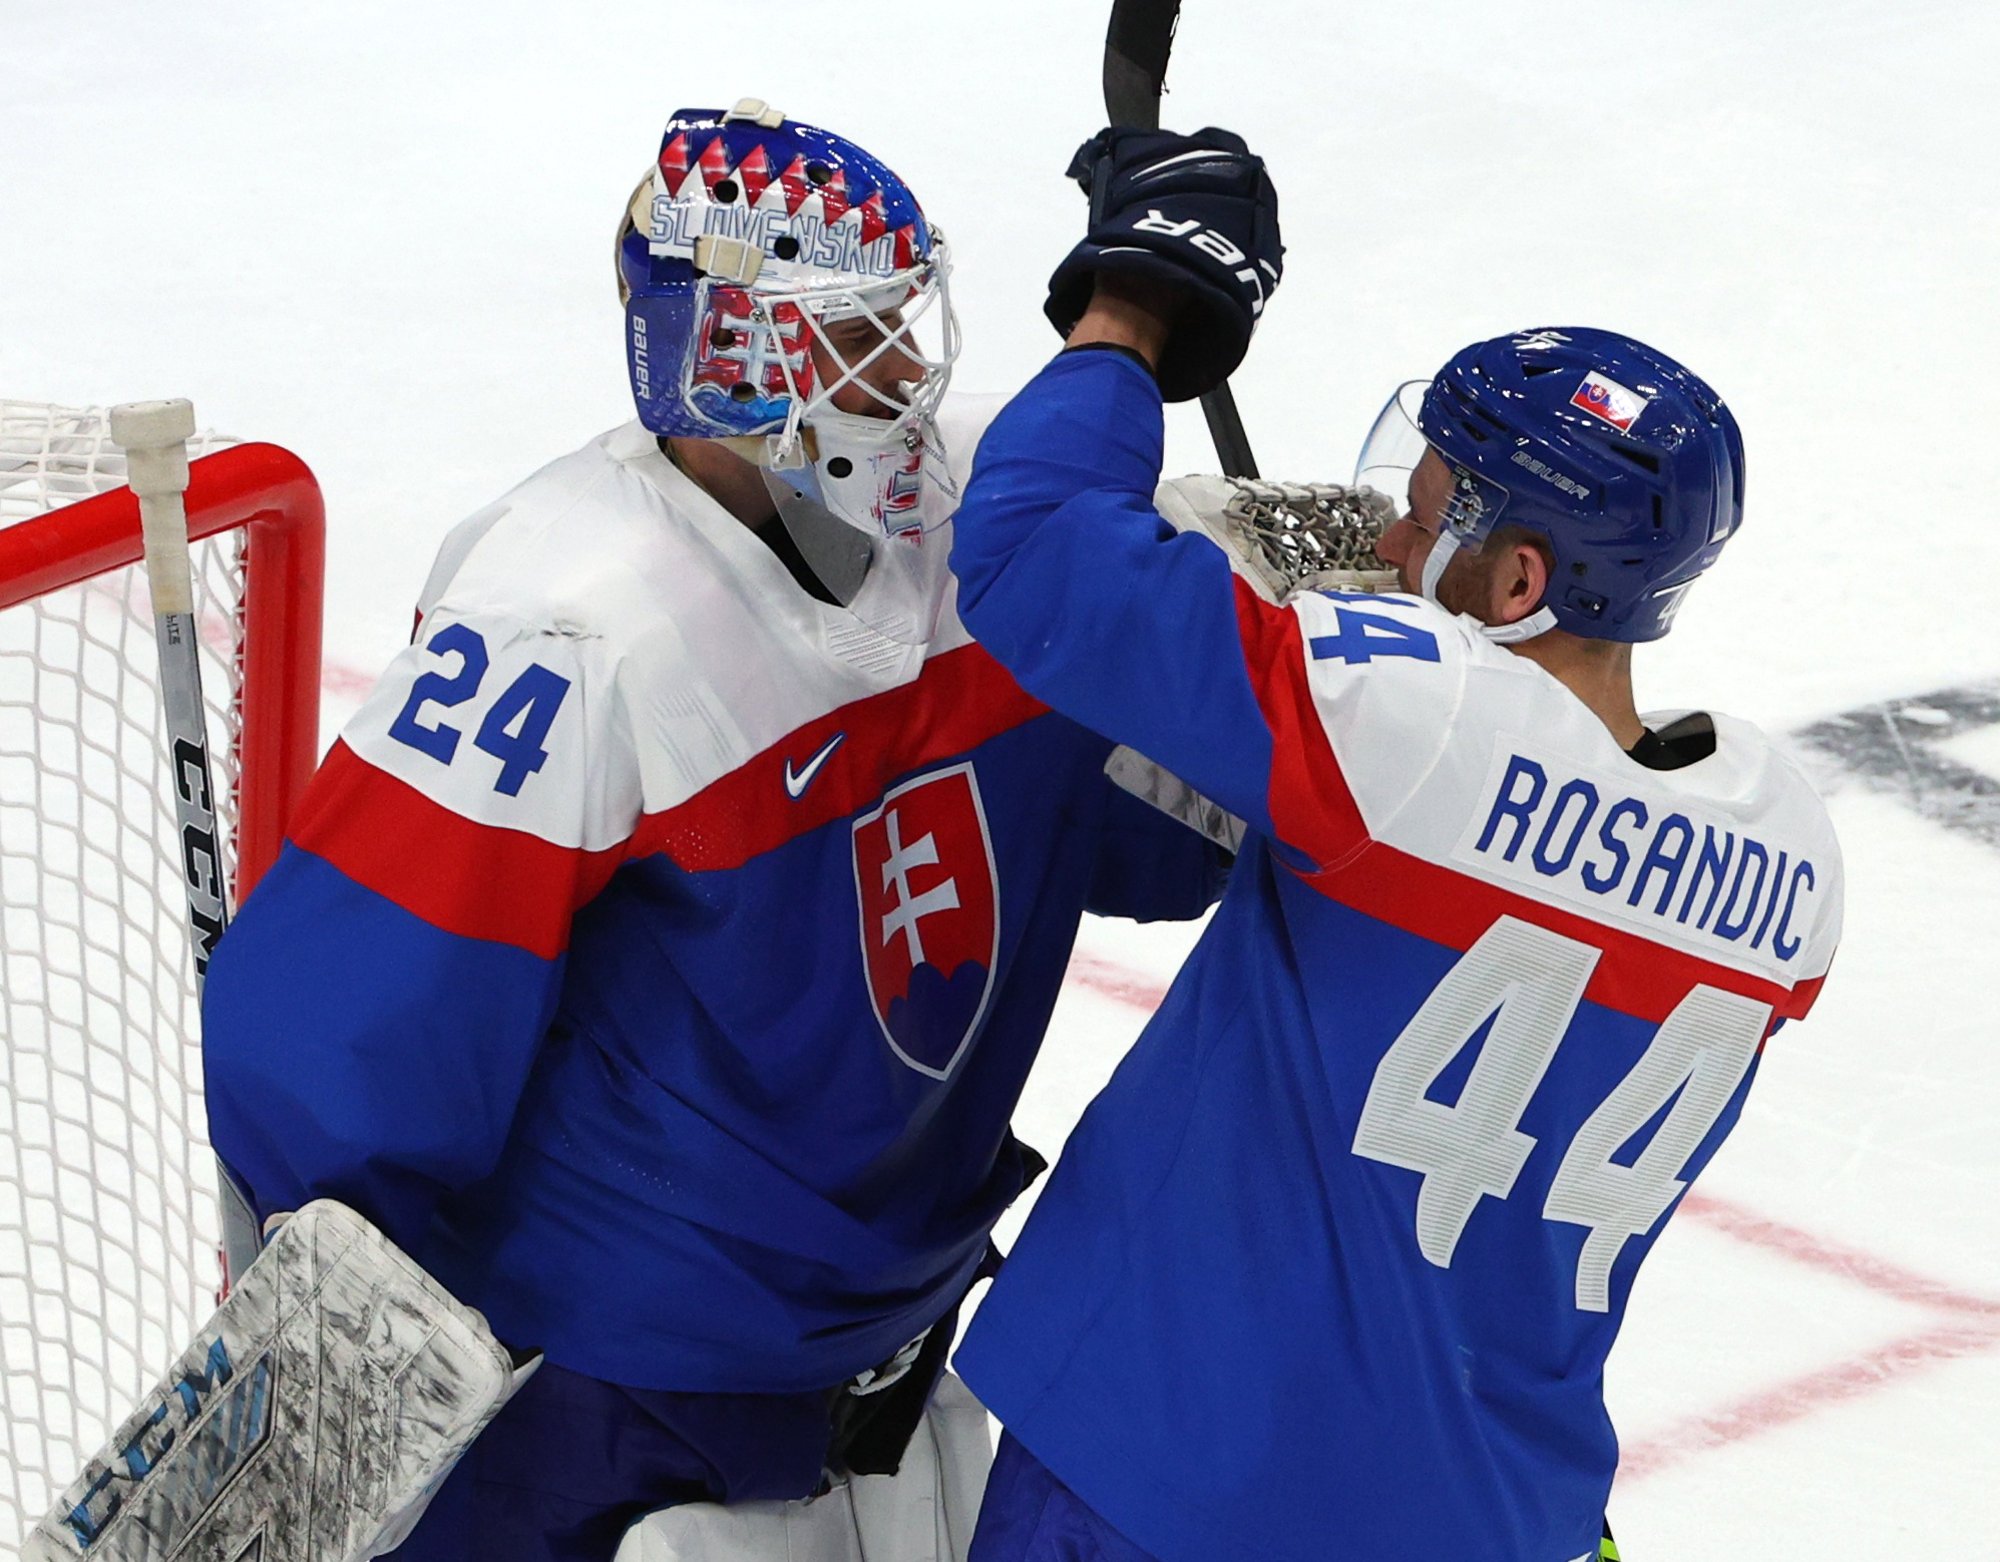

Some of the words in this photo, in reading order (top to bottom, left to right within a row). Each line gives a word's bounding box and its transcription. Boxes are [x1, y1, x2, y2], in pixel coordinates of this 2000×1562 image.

[649, 194, 896, 277] SLOVENSKO
[387, 623, 571, 797] 24
[1310, 591, 1441, 665] 4
[1475, 754, 1815, 962] ROSANDIC
[1351, 914, 1774, 1313] 44
[64, 1335, 233, 1548] CCM
